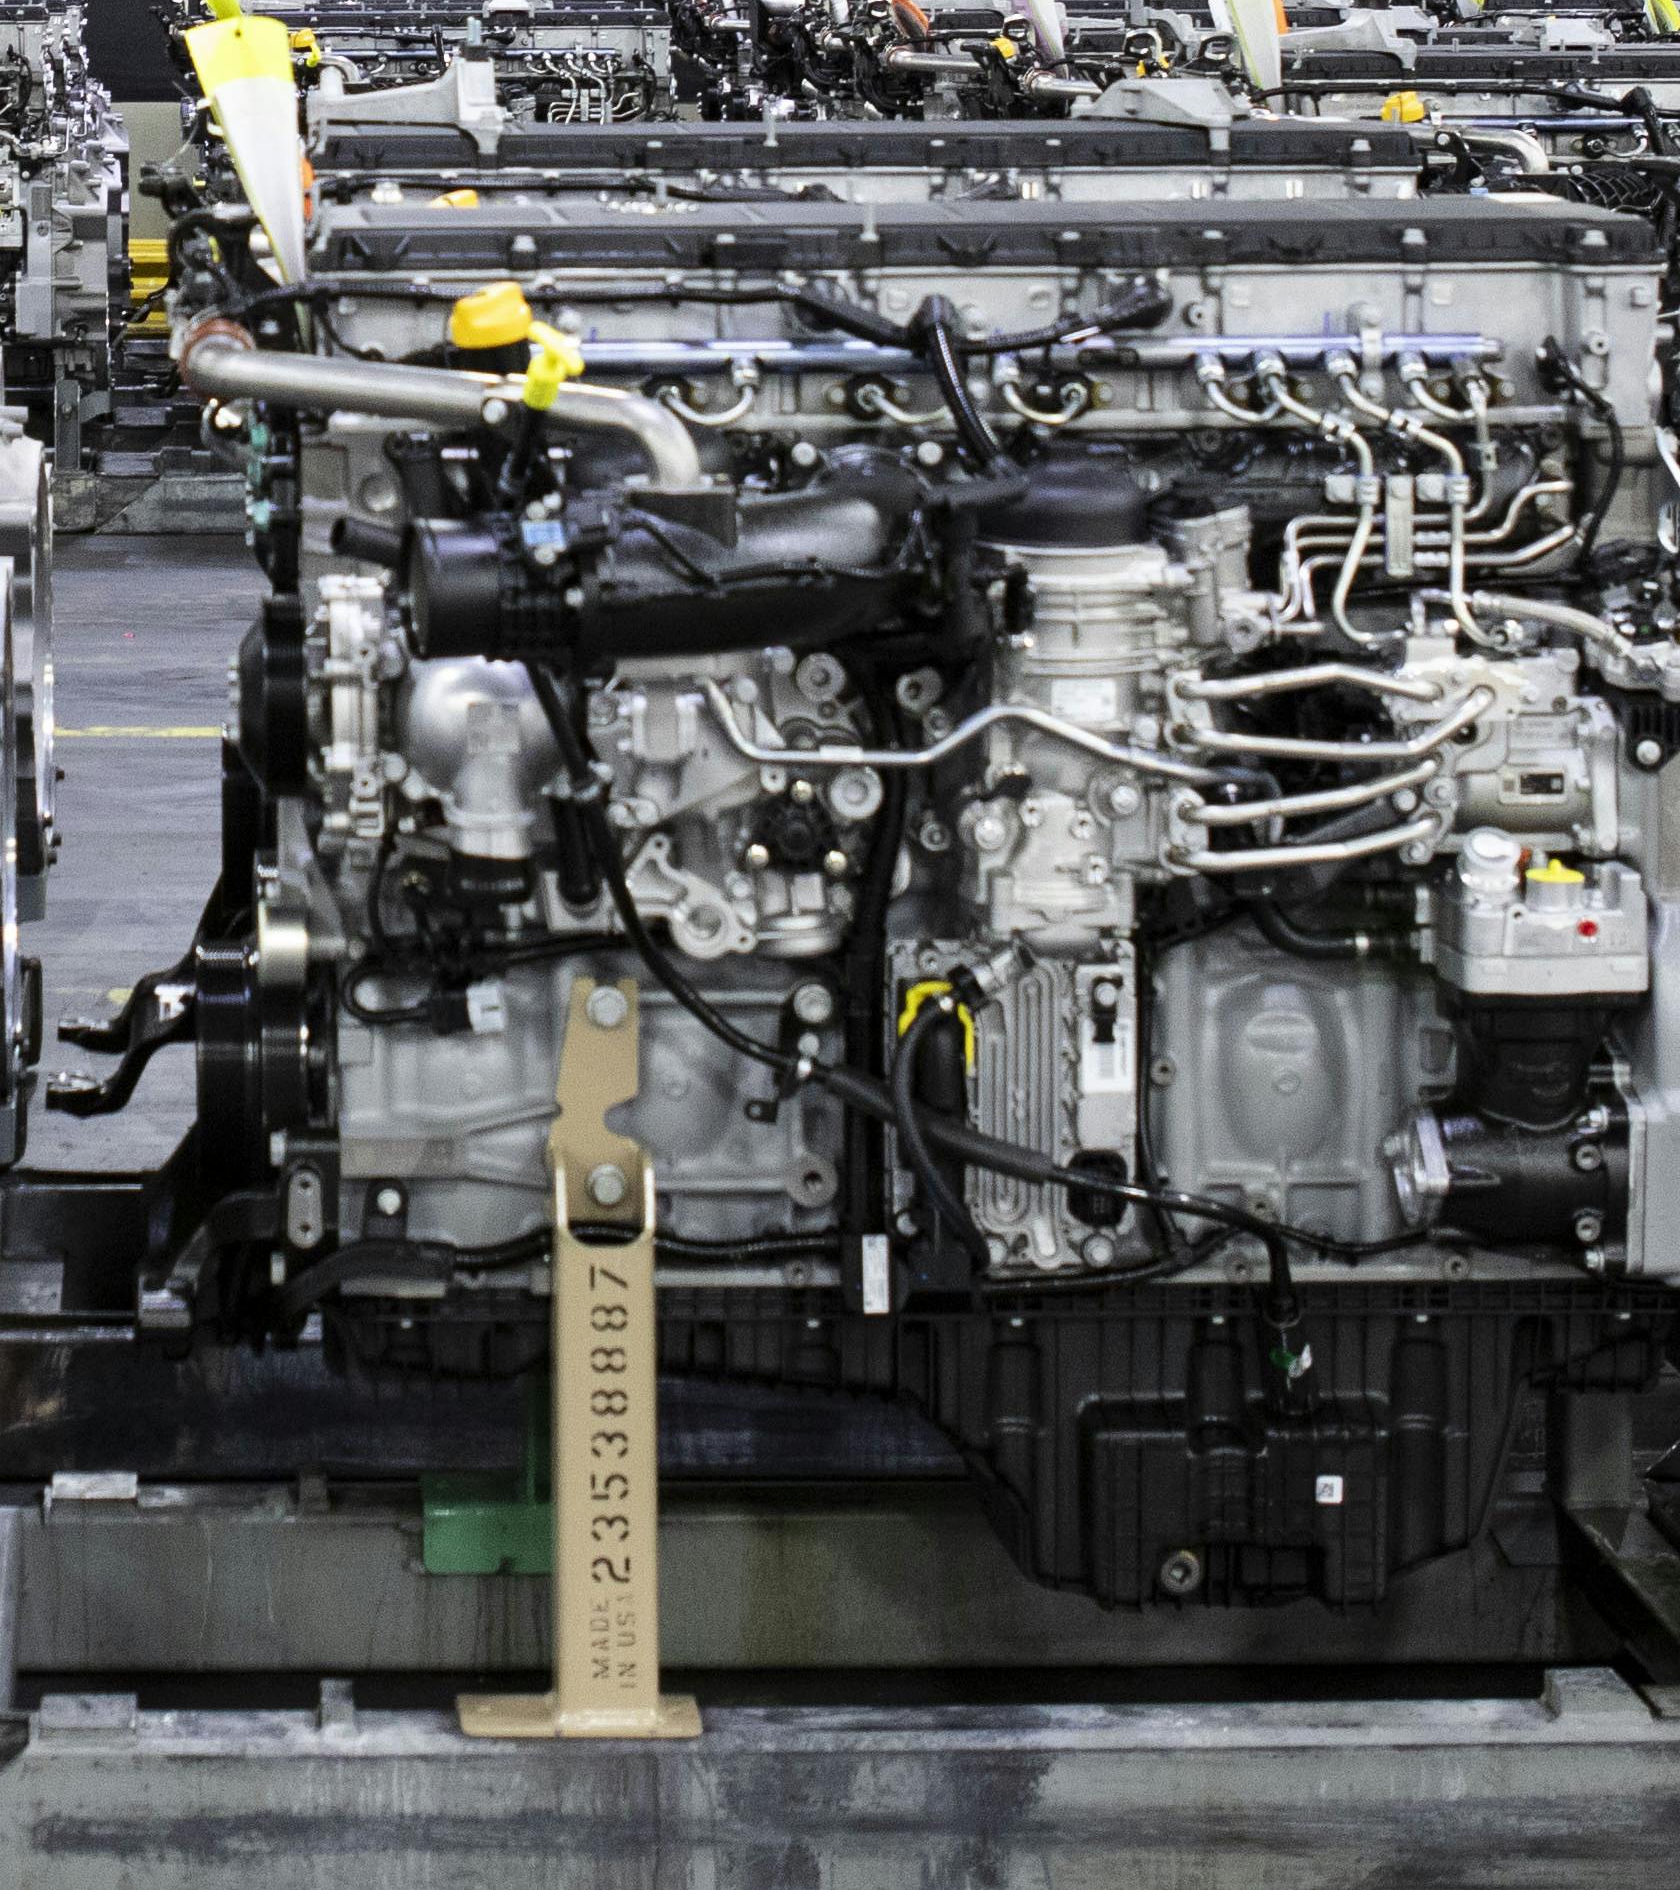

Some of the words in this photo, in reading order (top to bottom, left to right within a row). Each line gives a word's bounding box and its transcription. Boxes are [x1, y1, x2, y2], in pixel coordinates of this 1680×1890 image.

[590, 1263, 630, 1584] 23538887
[590, 1596, 610, 1680] MADE
[616, 1662, 637, 1689] IN
